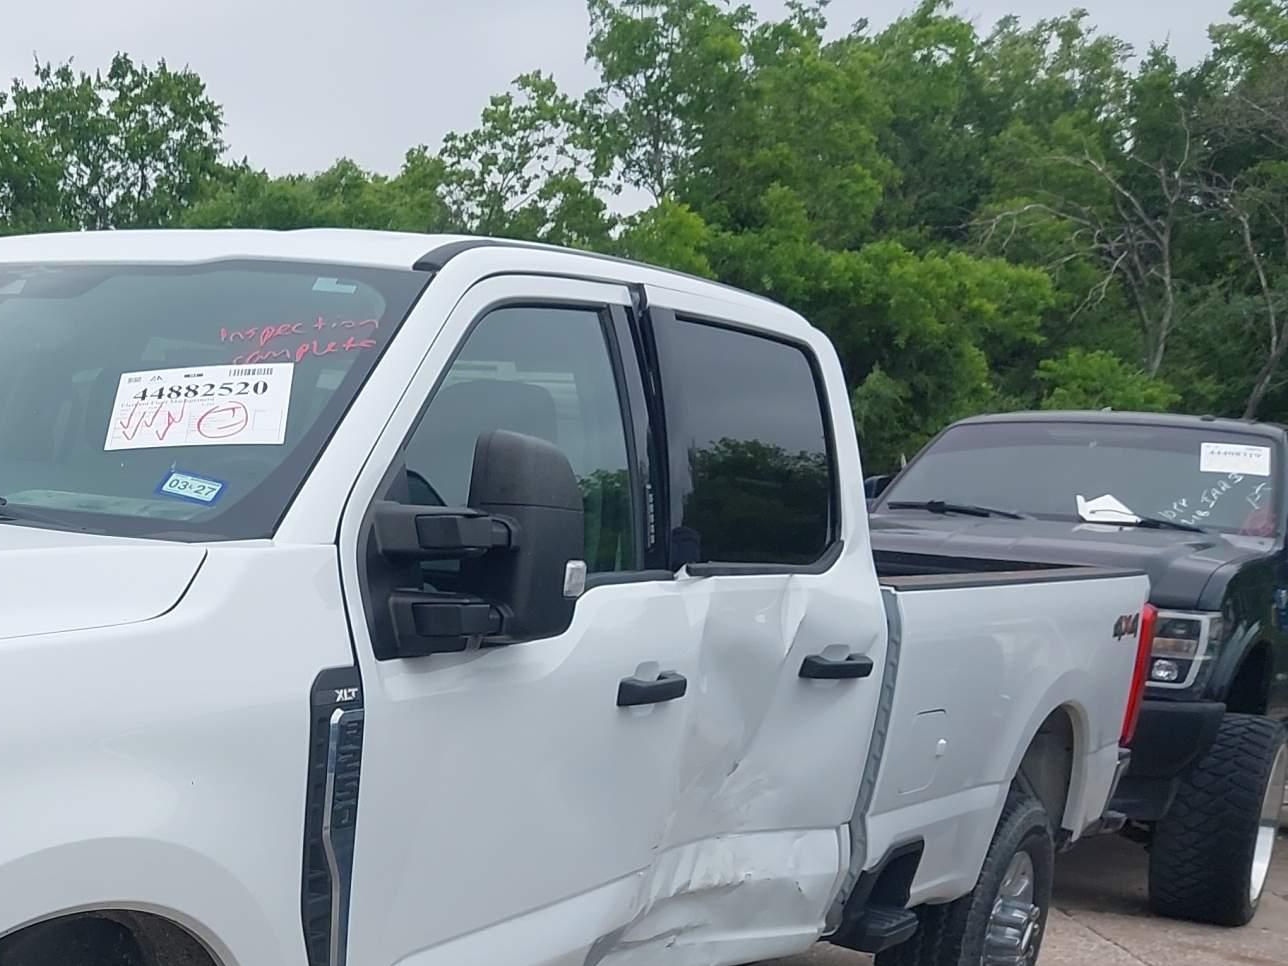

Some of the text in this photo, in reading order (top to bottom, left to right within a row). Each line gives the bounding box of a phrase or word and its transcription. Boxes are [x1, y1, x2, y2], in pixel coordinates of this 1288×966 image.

[133, 380, 268, 401] 44882520
[168, 478, 216, 497] 03 27
[334, 687, 359, 702] XLT
